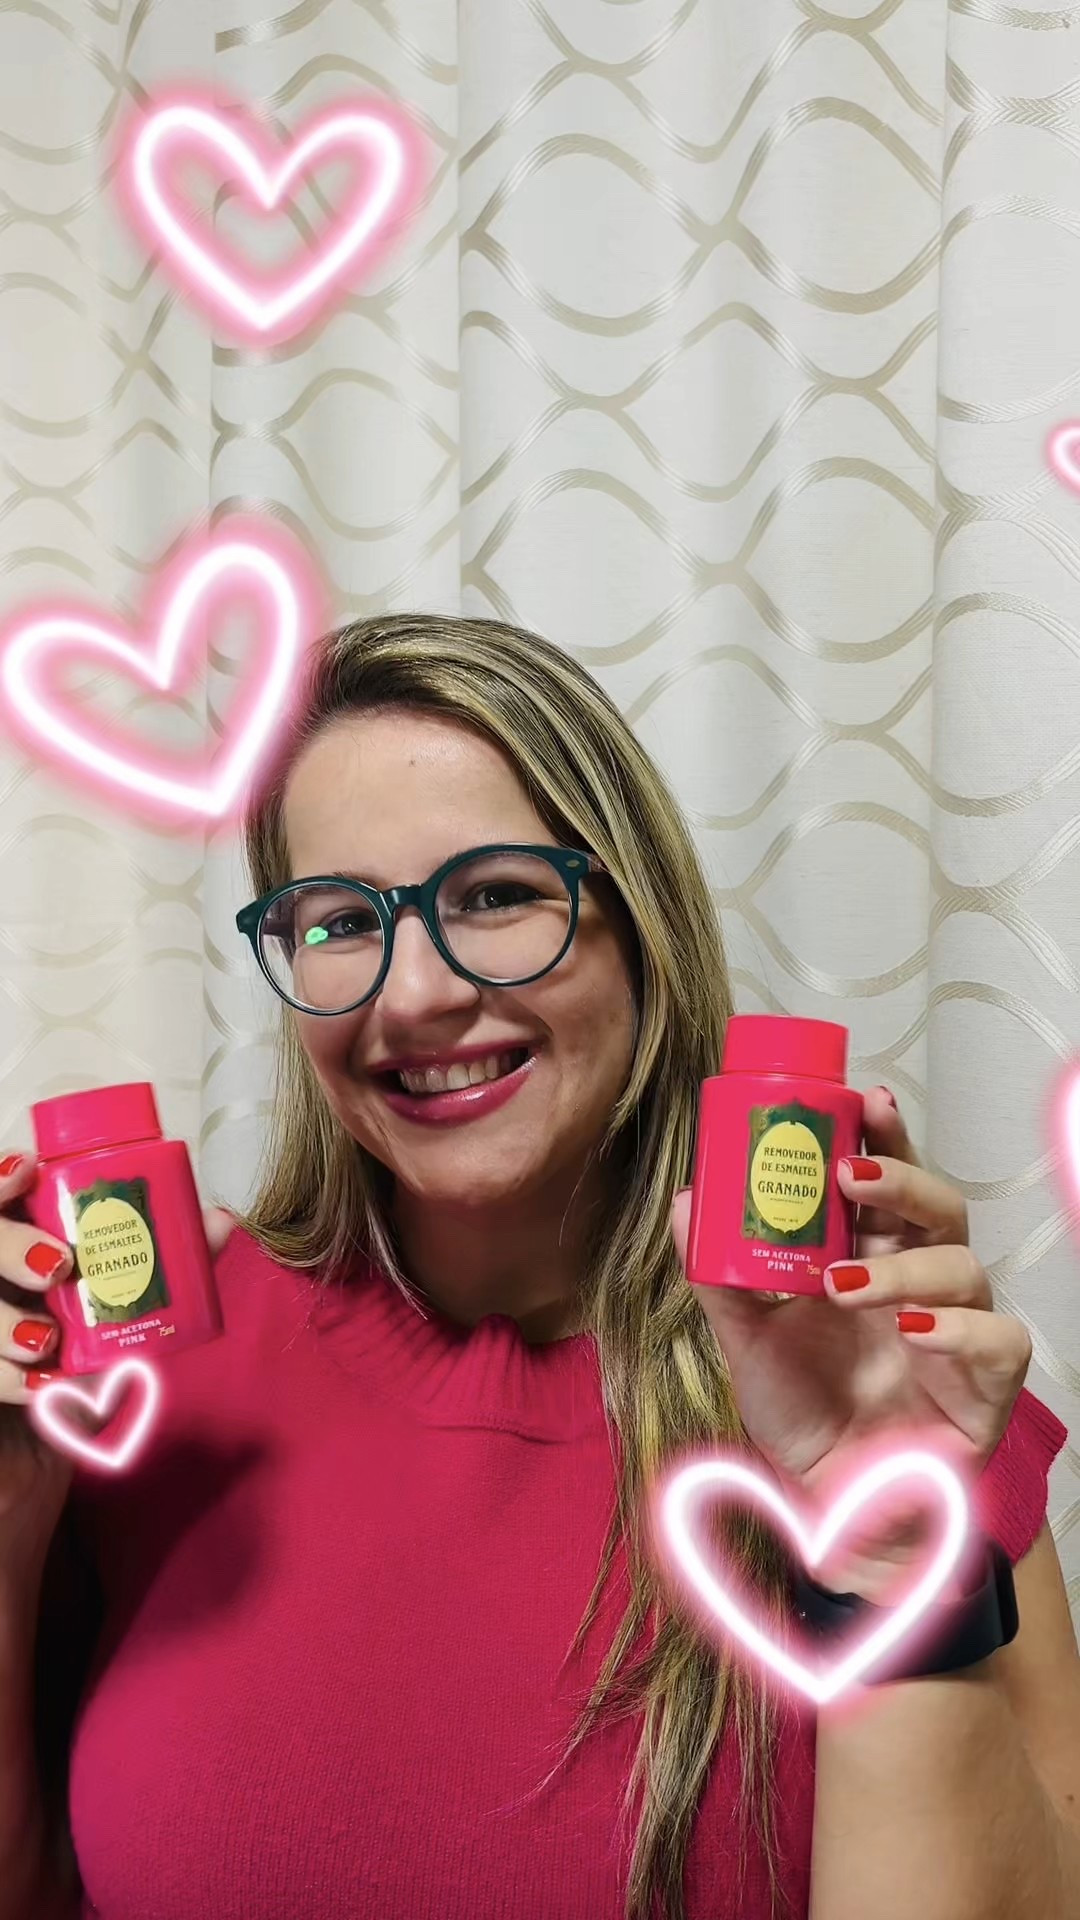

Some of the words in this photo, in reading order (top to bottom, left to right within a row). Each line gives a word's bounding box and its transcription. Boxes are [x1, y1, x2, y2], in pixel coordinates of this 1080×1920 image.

[764, 1147, 817, 1161] REMOVEDOR
[761, 1161, 773, 1172] DE
[775, 1163, 817, 1177] ESMALTES
[758, 1180, 817, 1198] GRANADO
[83, 1219, 138, 1240] REMOVEDOR
[85, 1243, 96, 1256] DE
[98, 1233, 143, 1253] ESMALTES
[752, 1248, 770, 1258] SEM
[772, 1251, 811, 1262] ACETONA
[87, 1252, 148, 1277] GRANADO
[767, 1261, 794, 1272] PINK
[101, 1328, 120, 1341] SEM
[121, 1319, 162, 1335] ACETONA
[118, 1333, 146, 1347] PINK
